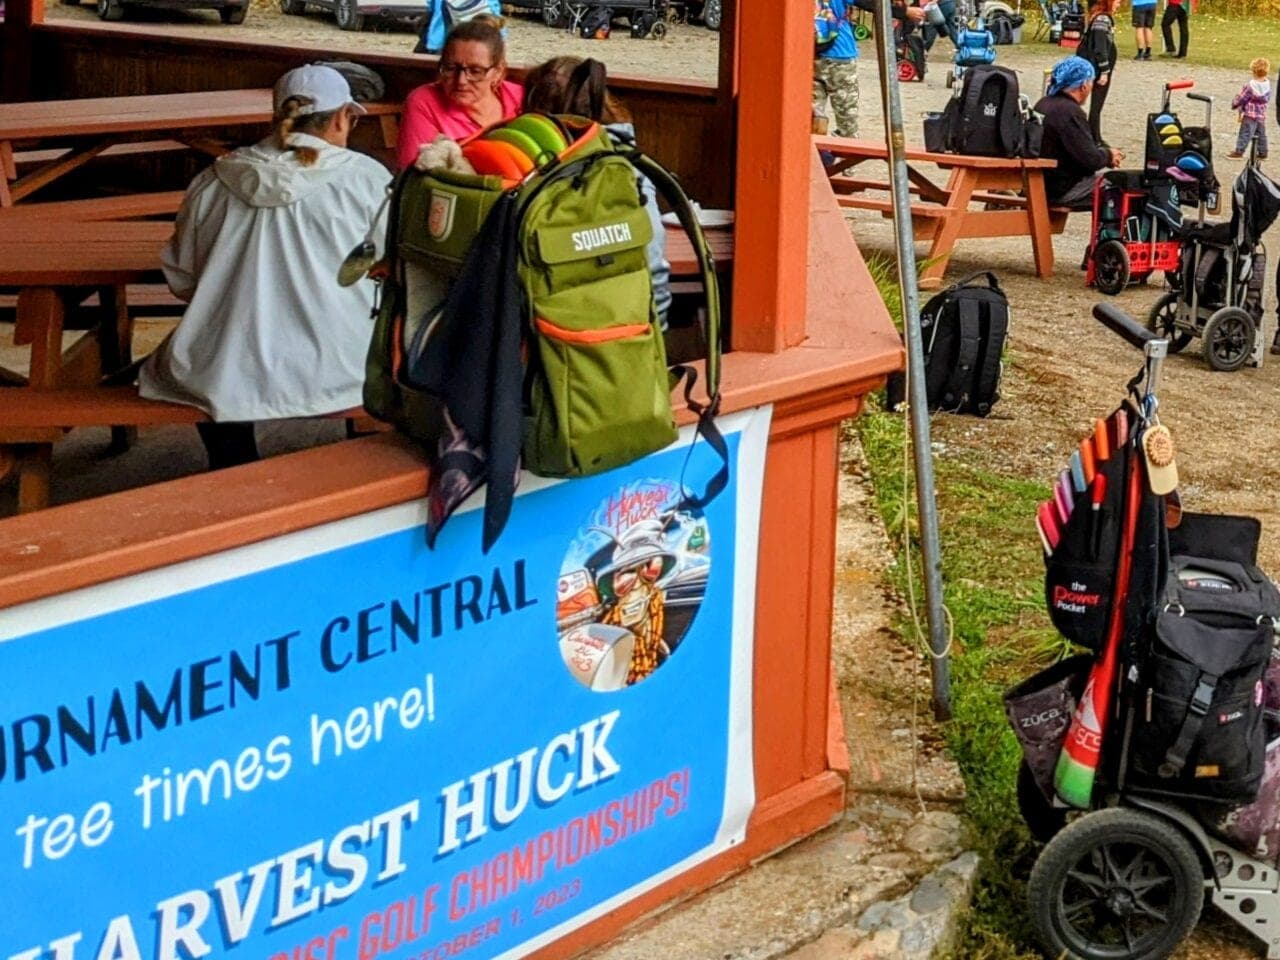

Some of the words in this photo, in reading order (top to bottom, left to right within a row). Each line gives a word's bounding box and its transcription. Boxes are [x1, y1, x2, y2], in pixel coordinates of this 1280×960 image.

[571, 222, 632, 251] SQUATCH
[1055, 584, 1101, 607] Power
[1071, 581, 1087, 591] the
[1056, 601, 1086, 613] Pocket
[0, 630, 300, 783] RNAMENT
[320, 559, 538, 673] CENTRAL
[15, 801, 114, 870] tee
[133, 735, 292, 830] times
[310, 673, 436, 765] here!
[436, 709, 621, 856] HUCK
[358, 884, 441, 960] GOLF
[448, 766, 691, 922] CHAMPIONSHIPS!
[532, 878, 581, 916] 2023
